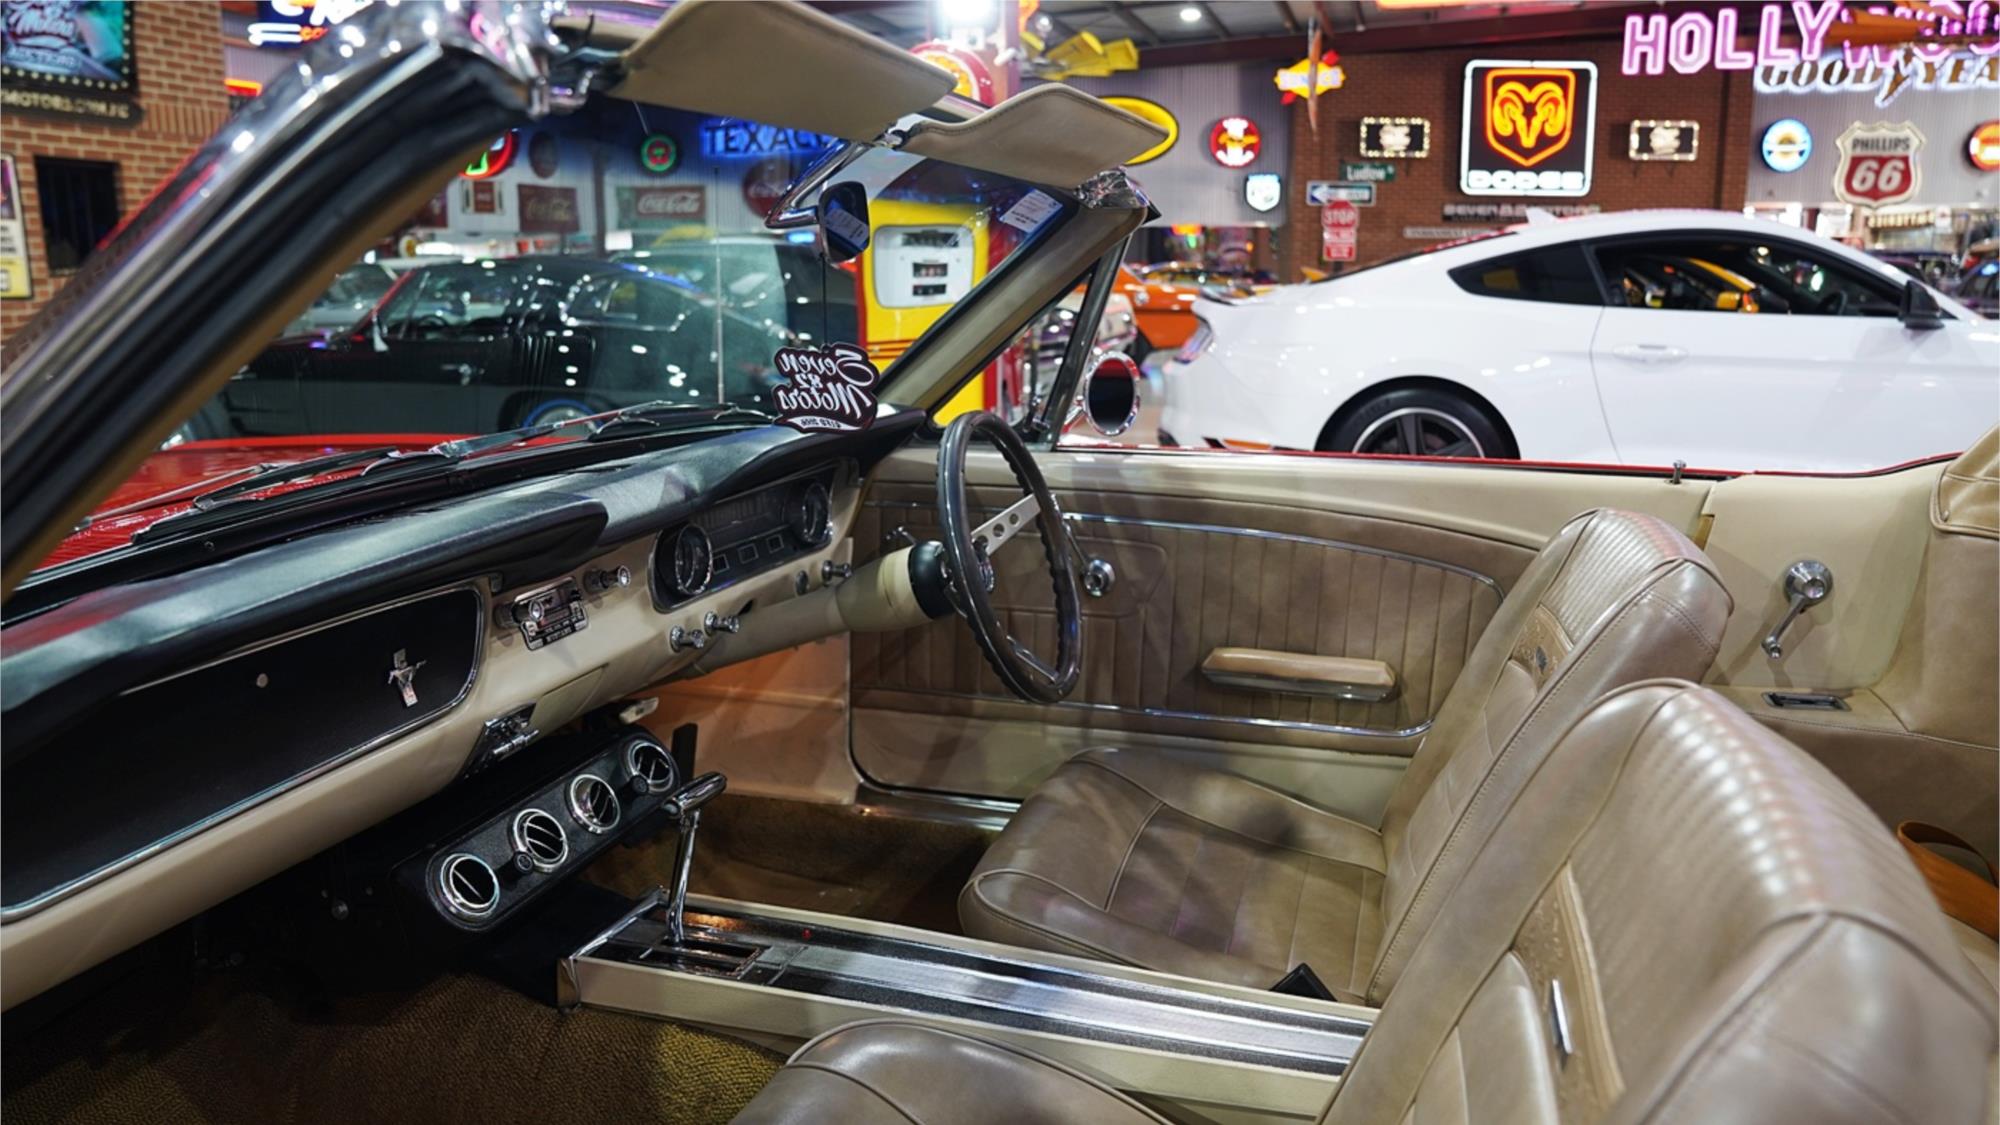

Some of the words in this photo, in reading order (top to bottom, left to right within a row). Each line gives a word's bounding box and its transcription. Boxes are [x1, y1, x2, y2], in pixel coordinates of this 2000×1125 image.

[1621, 0, 2000, 75] HOLLYW
[1852, 136, 1910, 151] PHILLIPS
[1467, 170, 1584, 190] DODGE
[1851, 158, 1905, 193] 66
[1324, 208, 1357, 224] STOP
